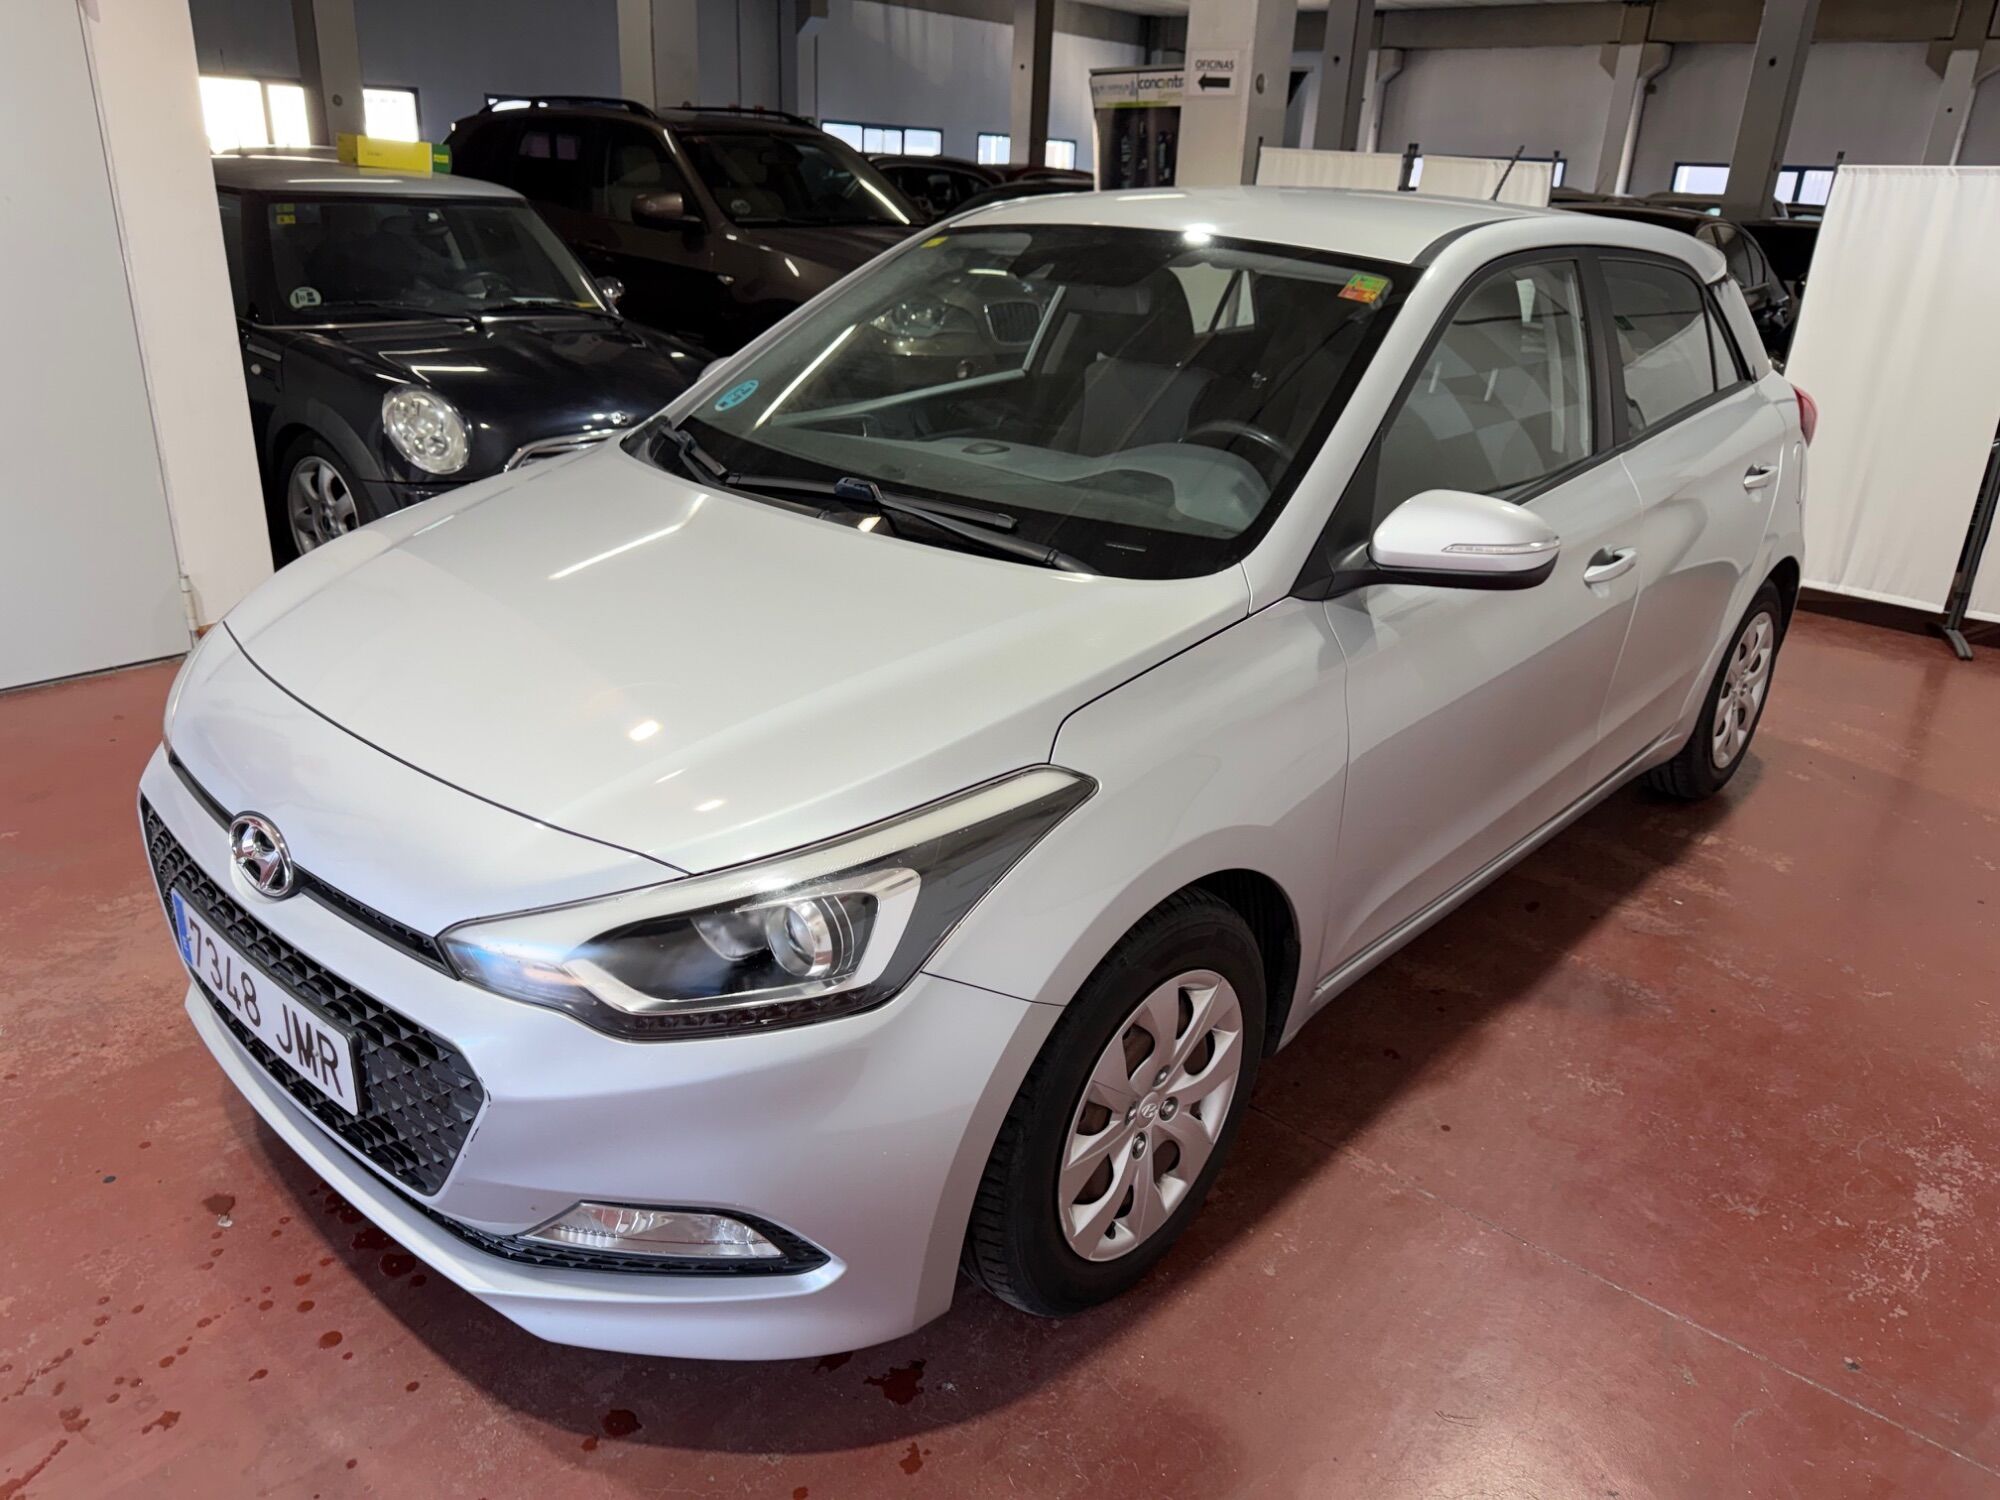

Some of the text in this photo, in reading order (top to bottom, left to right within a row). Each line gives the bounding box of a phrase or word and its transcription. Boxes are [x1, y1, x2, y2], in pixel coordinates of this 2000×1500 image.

[1195, 59, 1235, 71] OFICINAS
[189, 916, 344, 1097] 7348 JMR
